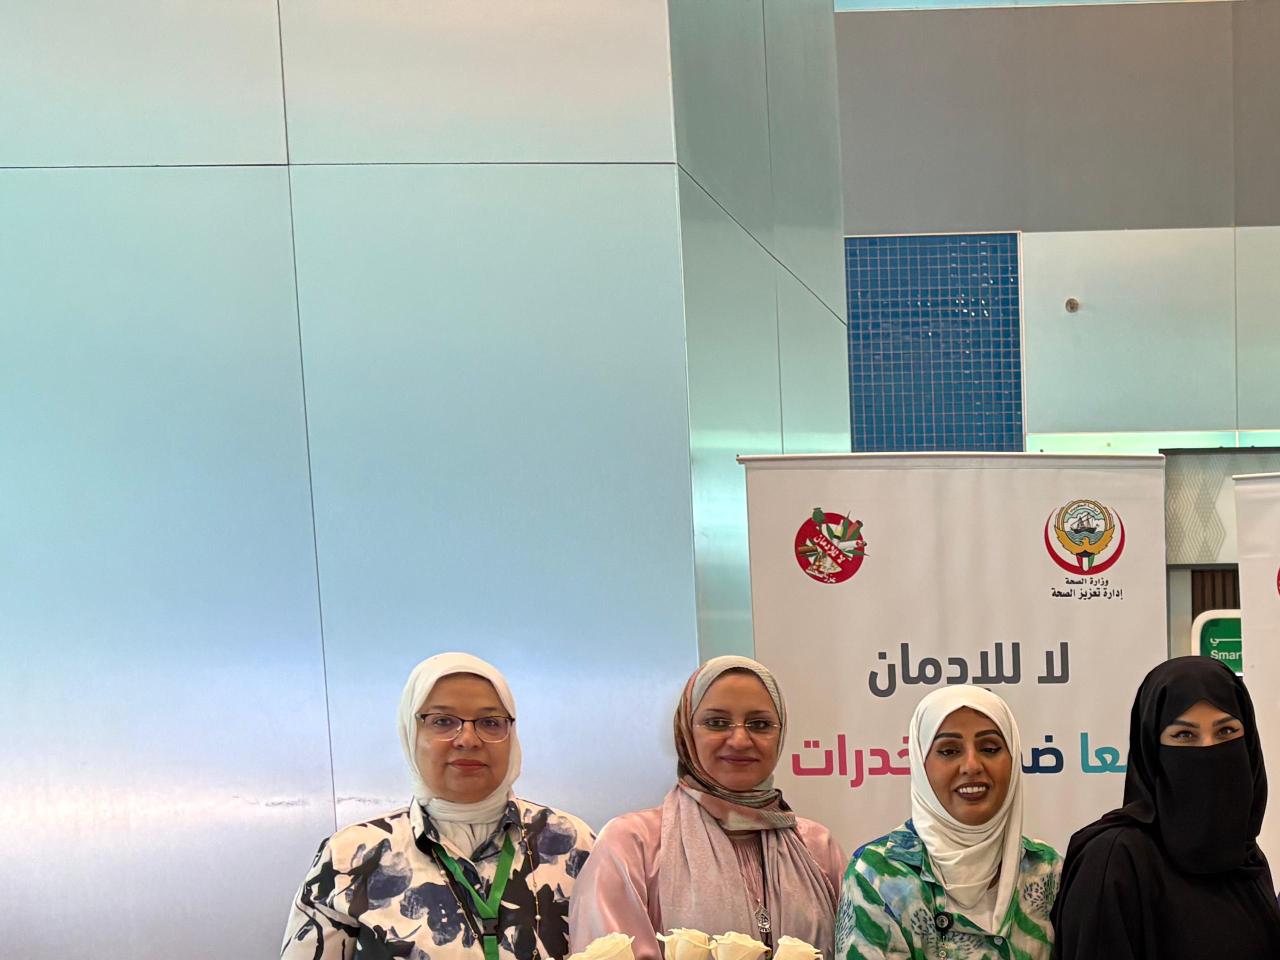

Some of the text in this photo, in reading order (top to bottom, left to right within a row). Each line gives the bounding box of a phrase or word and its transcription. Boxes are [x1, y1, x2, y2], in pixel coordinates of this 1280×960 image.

[1065, 577, 1109, 586] وزارة الصحة
[1051, 588, 1076, 598] الصحة
[1078, 588, 1101, 600] تعزيز
[1210, 650, 1242, 660] Smar
[1037, 642, 1069, 684] لا
[1080, 732, 1127, 774] عا
